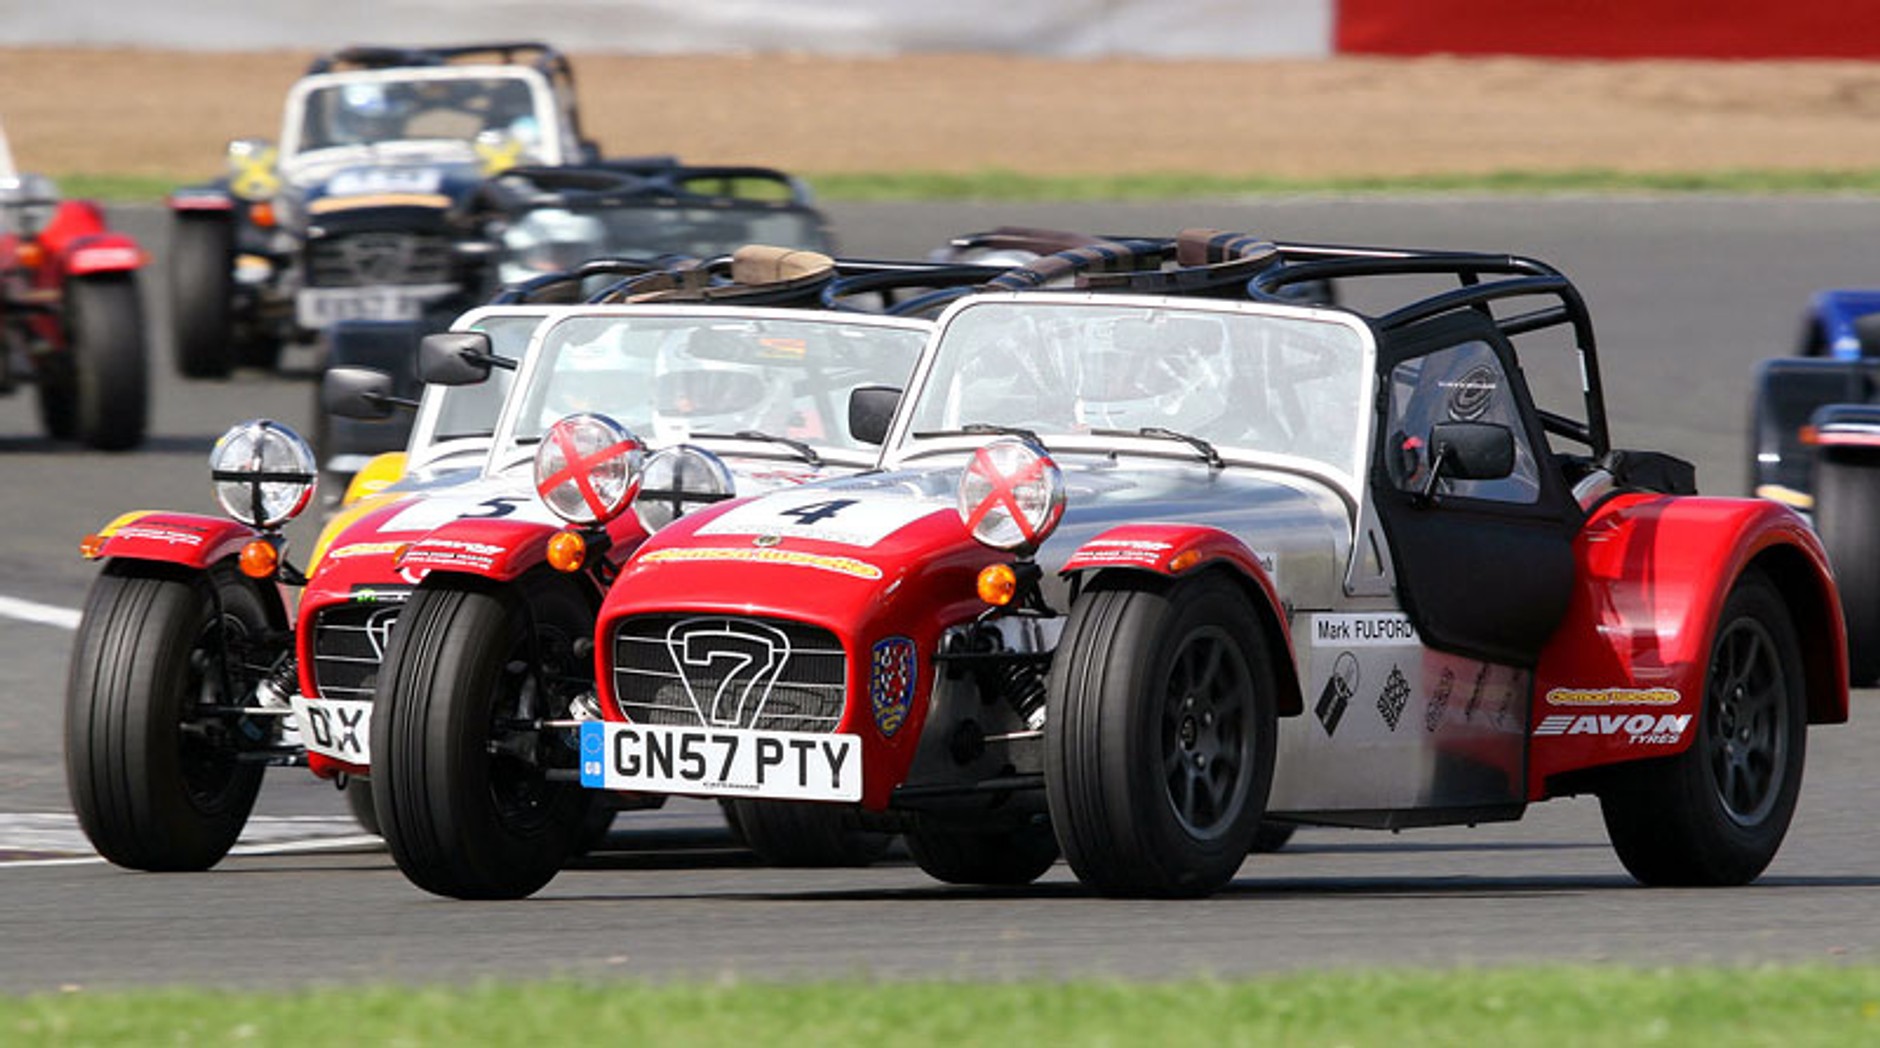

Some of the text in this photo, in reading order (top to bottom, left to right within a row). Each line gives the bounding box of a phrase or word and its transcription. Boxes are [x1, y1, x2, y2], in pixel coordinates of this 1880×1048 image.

[778, 498, 861, 525] 4
[1318, 619, 1414, 639] Mark FULFORD
[683, 630, 774, 725] 7
[1567, 714, 1693, 735] AVON
[1628, 734, 1681, 744] TYRES
[613, 729, 850, 789] GN57 PTY
